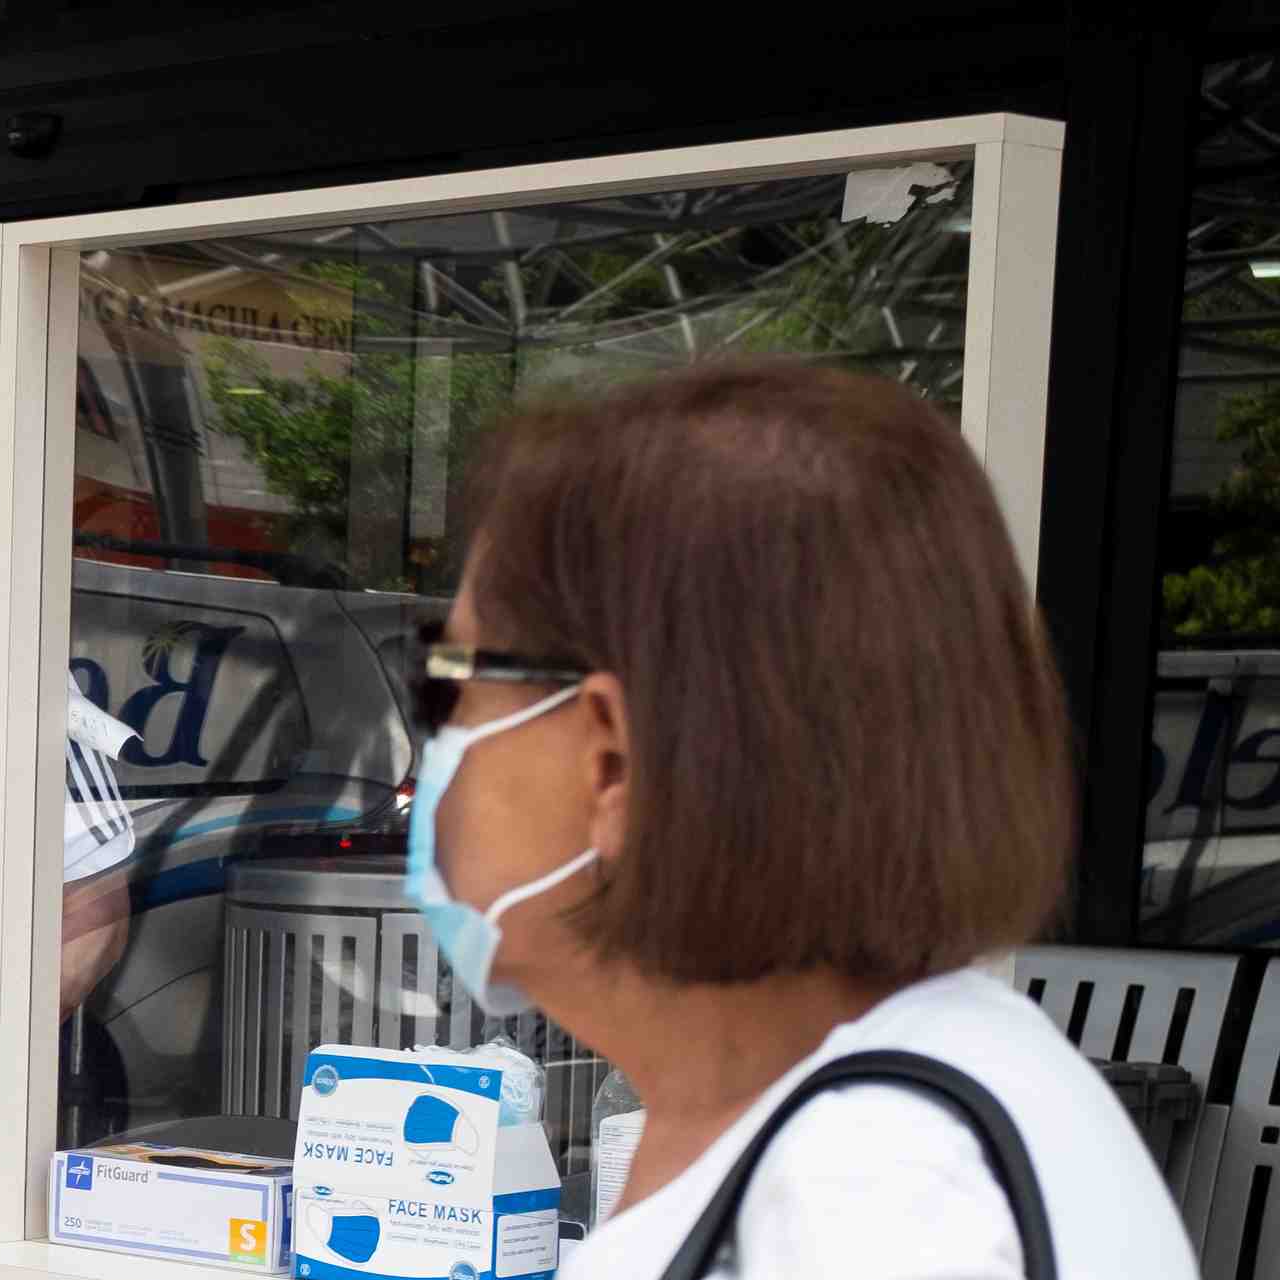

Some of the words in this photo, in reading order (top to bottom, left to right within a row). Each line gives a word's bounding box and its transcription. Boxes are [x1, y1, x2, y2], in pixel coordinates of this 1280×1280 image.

[303, 1141, 349, 1161] MASK
[356, 1147, 395, 1167] FACE
[388, 1199, 428, 1218] FACE
[433, 1204, 483, 1225] MASK
[239, 1222, 257, 1252] S
